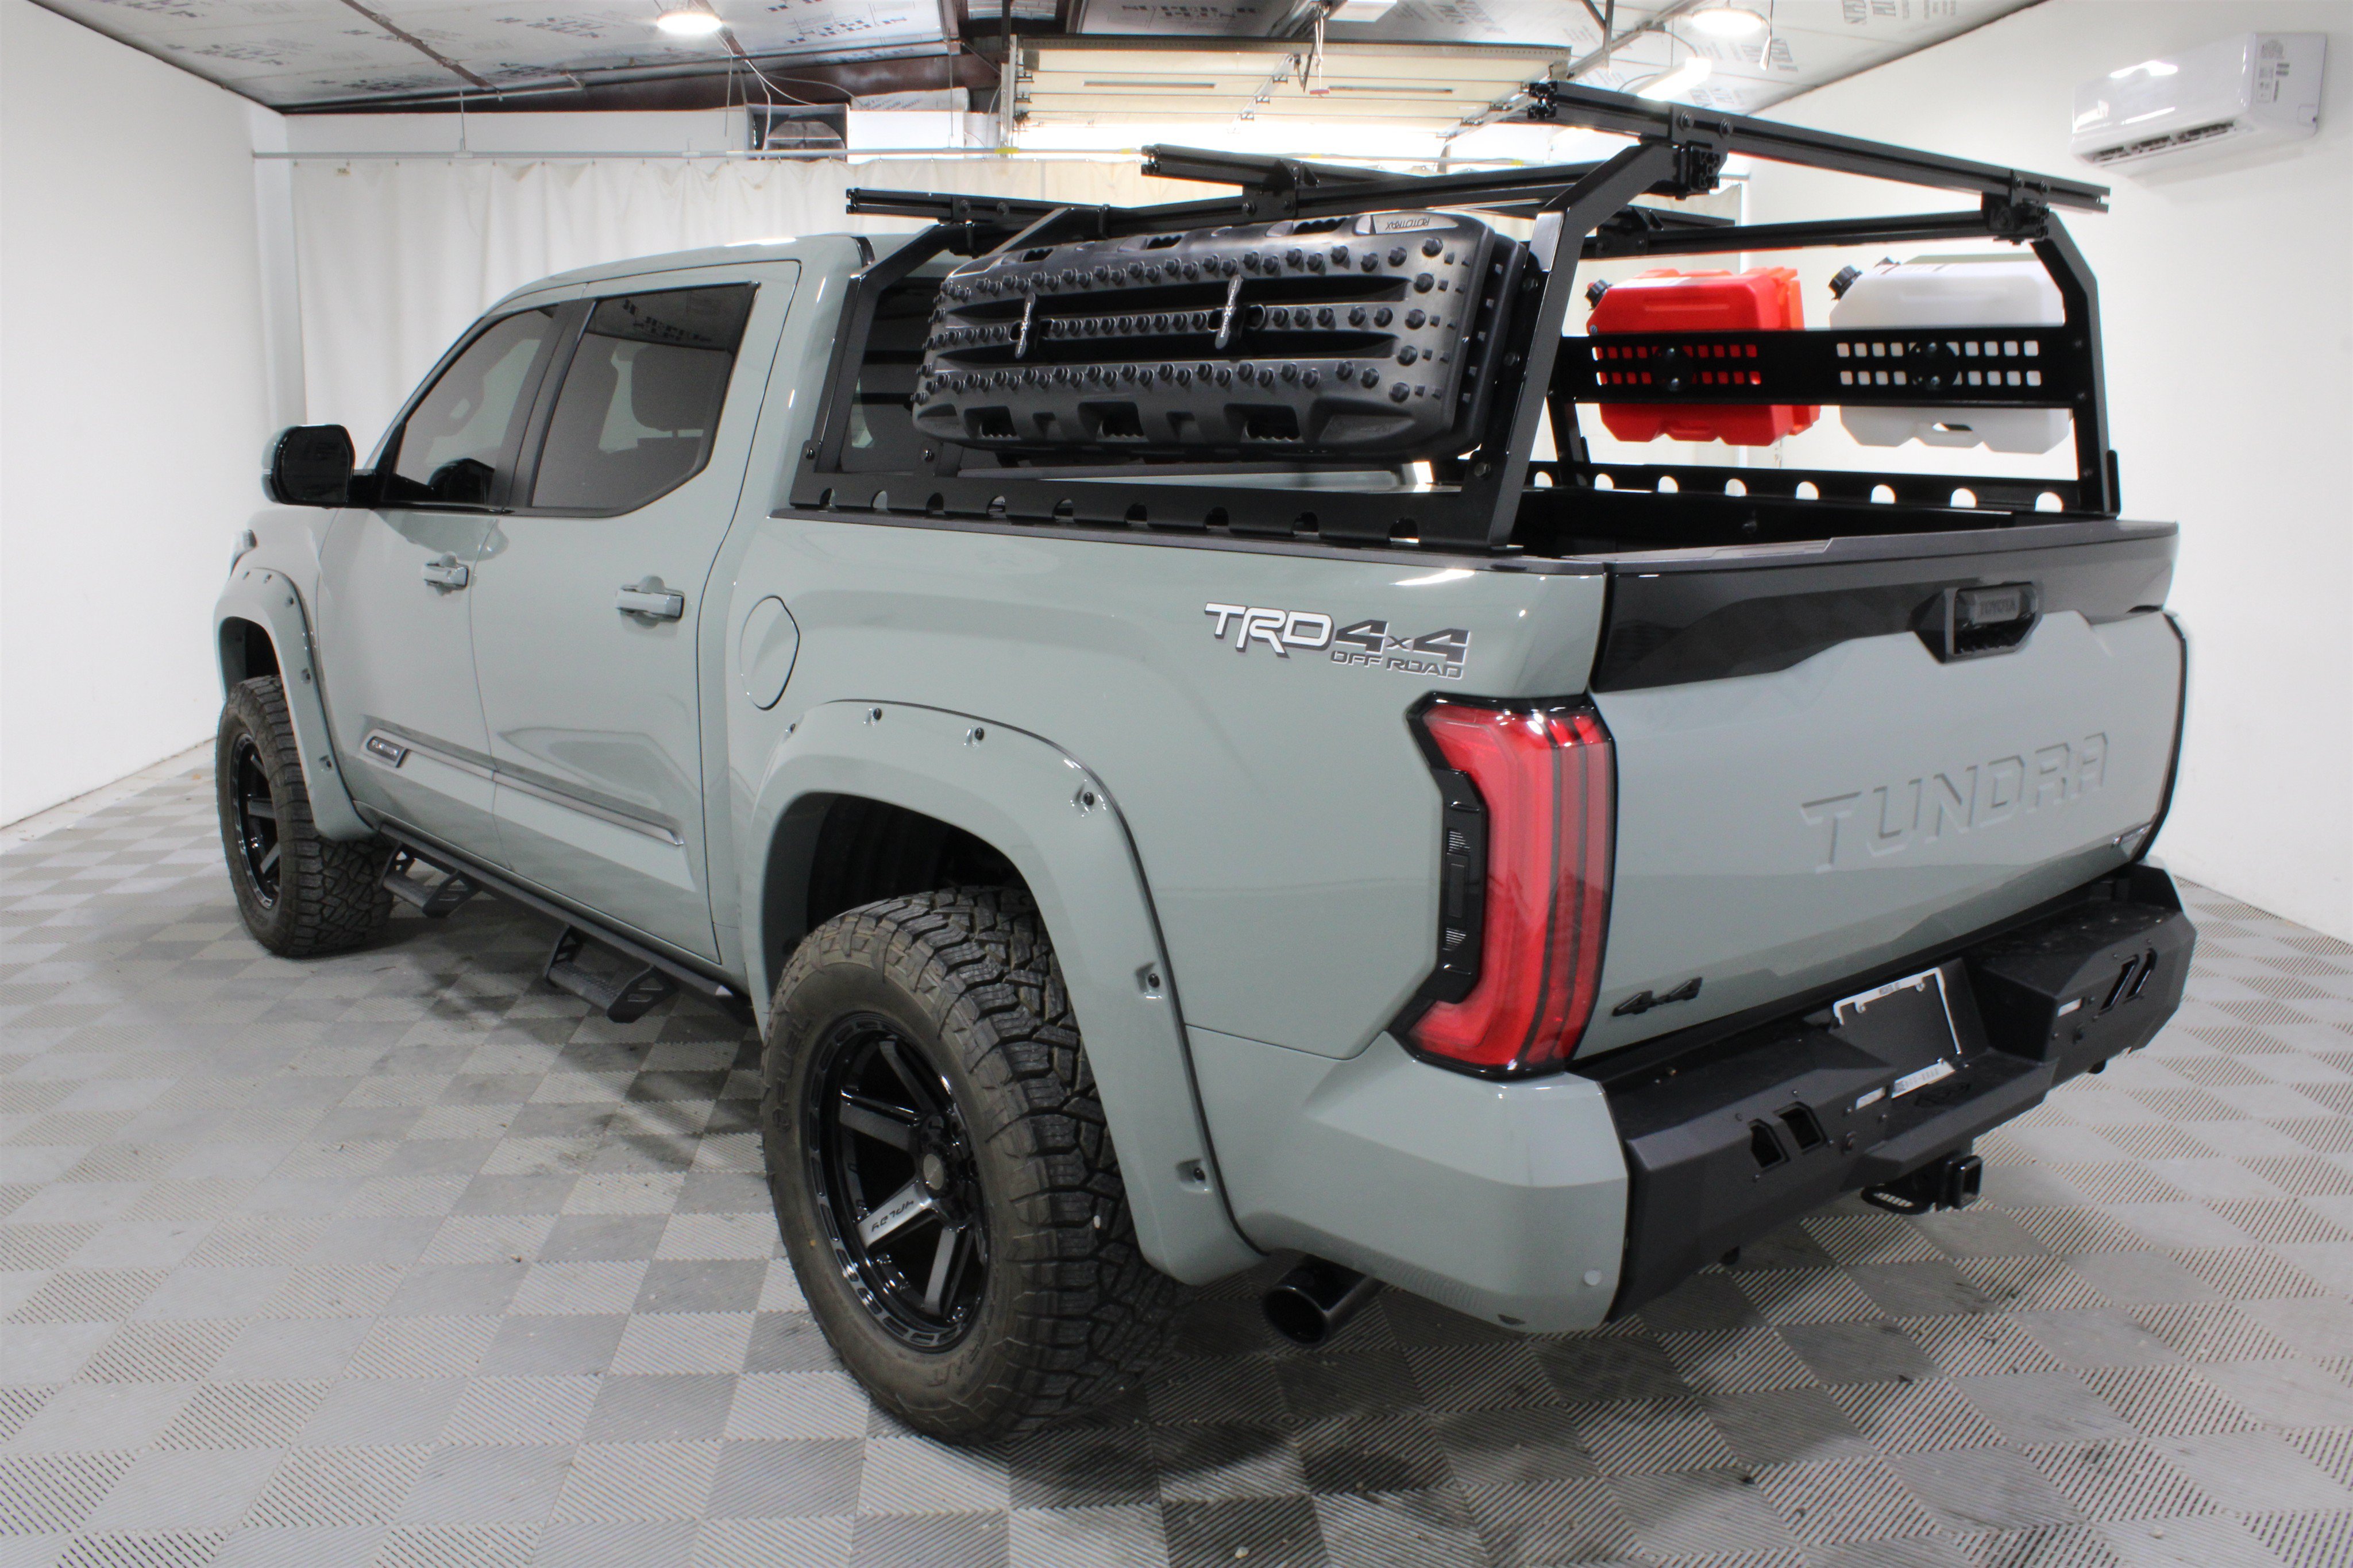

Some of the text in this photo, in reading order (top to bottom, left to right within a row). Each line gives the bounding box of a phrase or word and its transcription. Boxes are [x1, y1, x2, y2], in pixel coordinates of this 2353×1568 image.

[1205, 602, 1334, 659] TRD
[1330, 650, 1464, 680] OFF ROAD
[1800, 732, 2109, 873] TUNDRA
